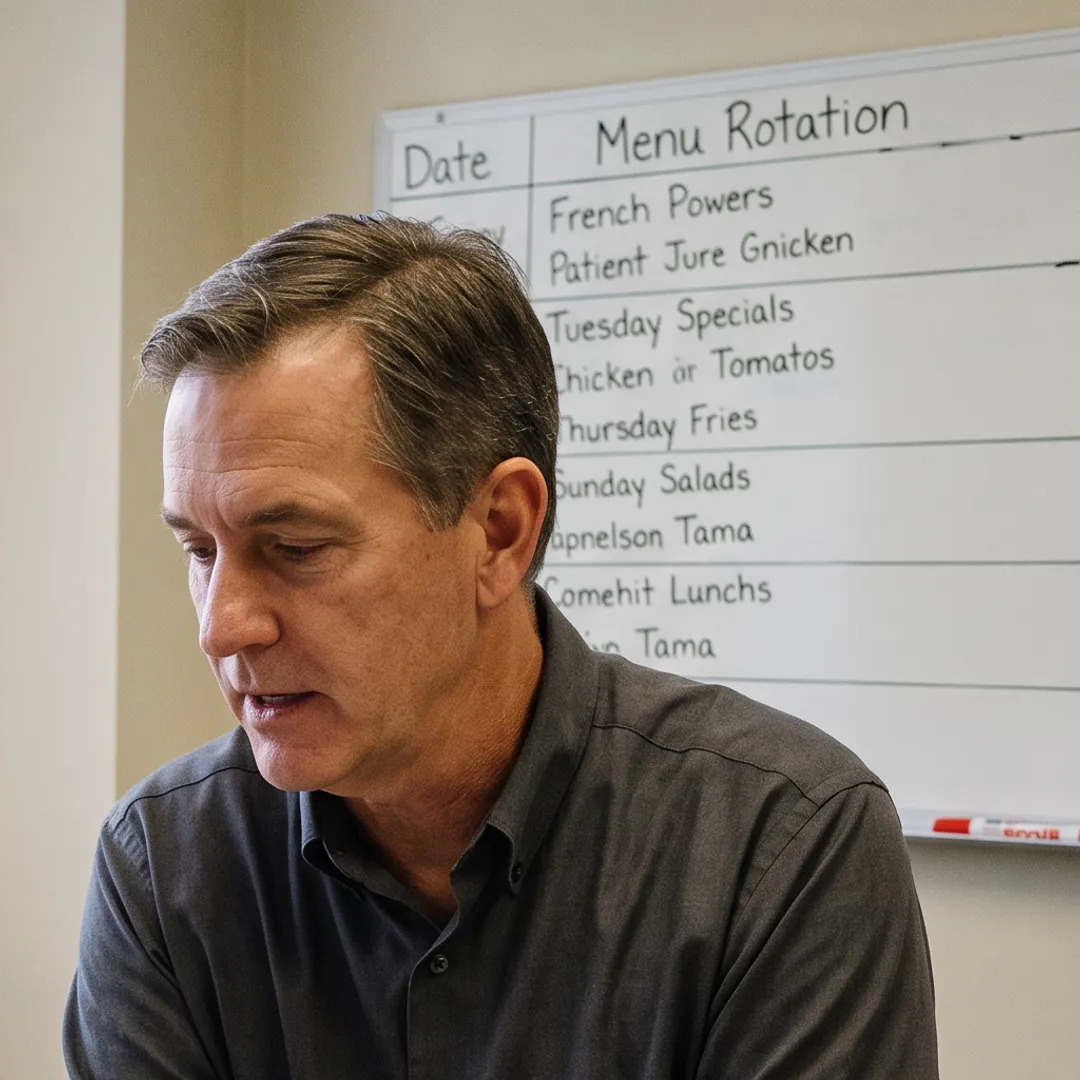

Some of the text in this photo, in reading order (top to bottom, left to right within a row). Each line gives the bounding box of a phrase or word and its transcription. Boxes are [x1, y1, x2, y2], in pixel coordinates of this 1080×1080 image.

[596, 95, 909, 165] Menu Rotation
[404, 140, 492, 190] Date
[550, 193, 650, 233] French
[668, 183, 774, 219] Powers
[550, 245, 648, 286] Patient
[664, 239, 726, 272] Jure
[545, 294, 795, 349] Tuesday Specials
[710, 342, 835, 379] Tomatos
[690, 403, 758, 436] Fries
[555, 461, 751, 509] Sunday Salads
[674, 514, 754, 545] Tama
[544, 573, 772, 608] Comehit Lunchs
[635, 627, 716, 659] Tama
